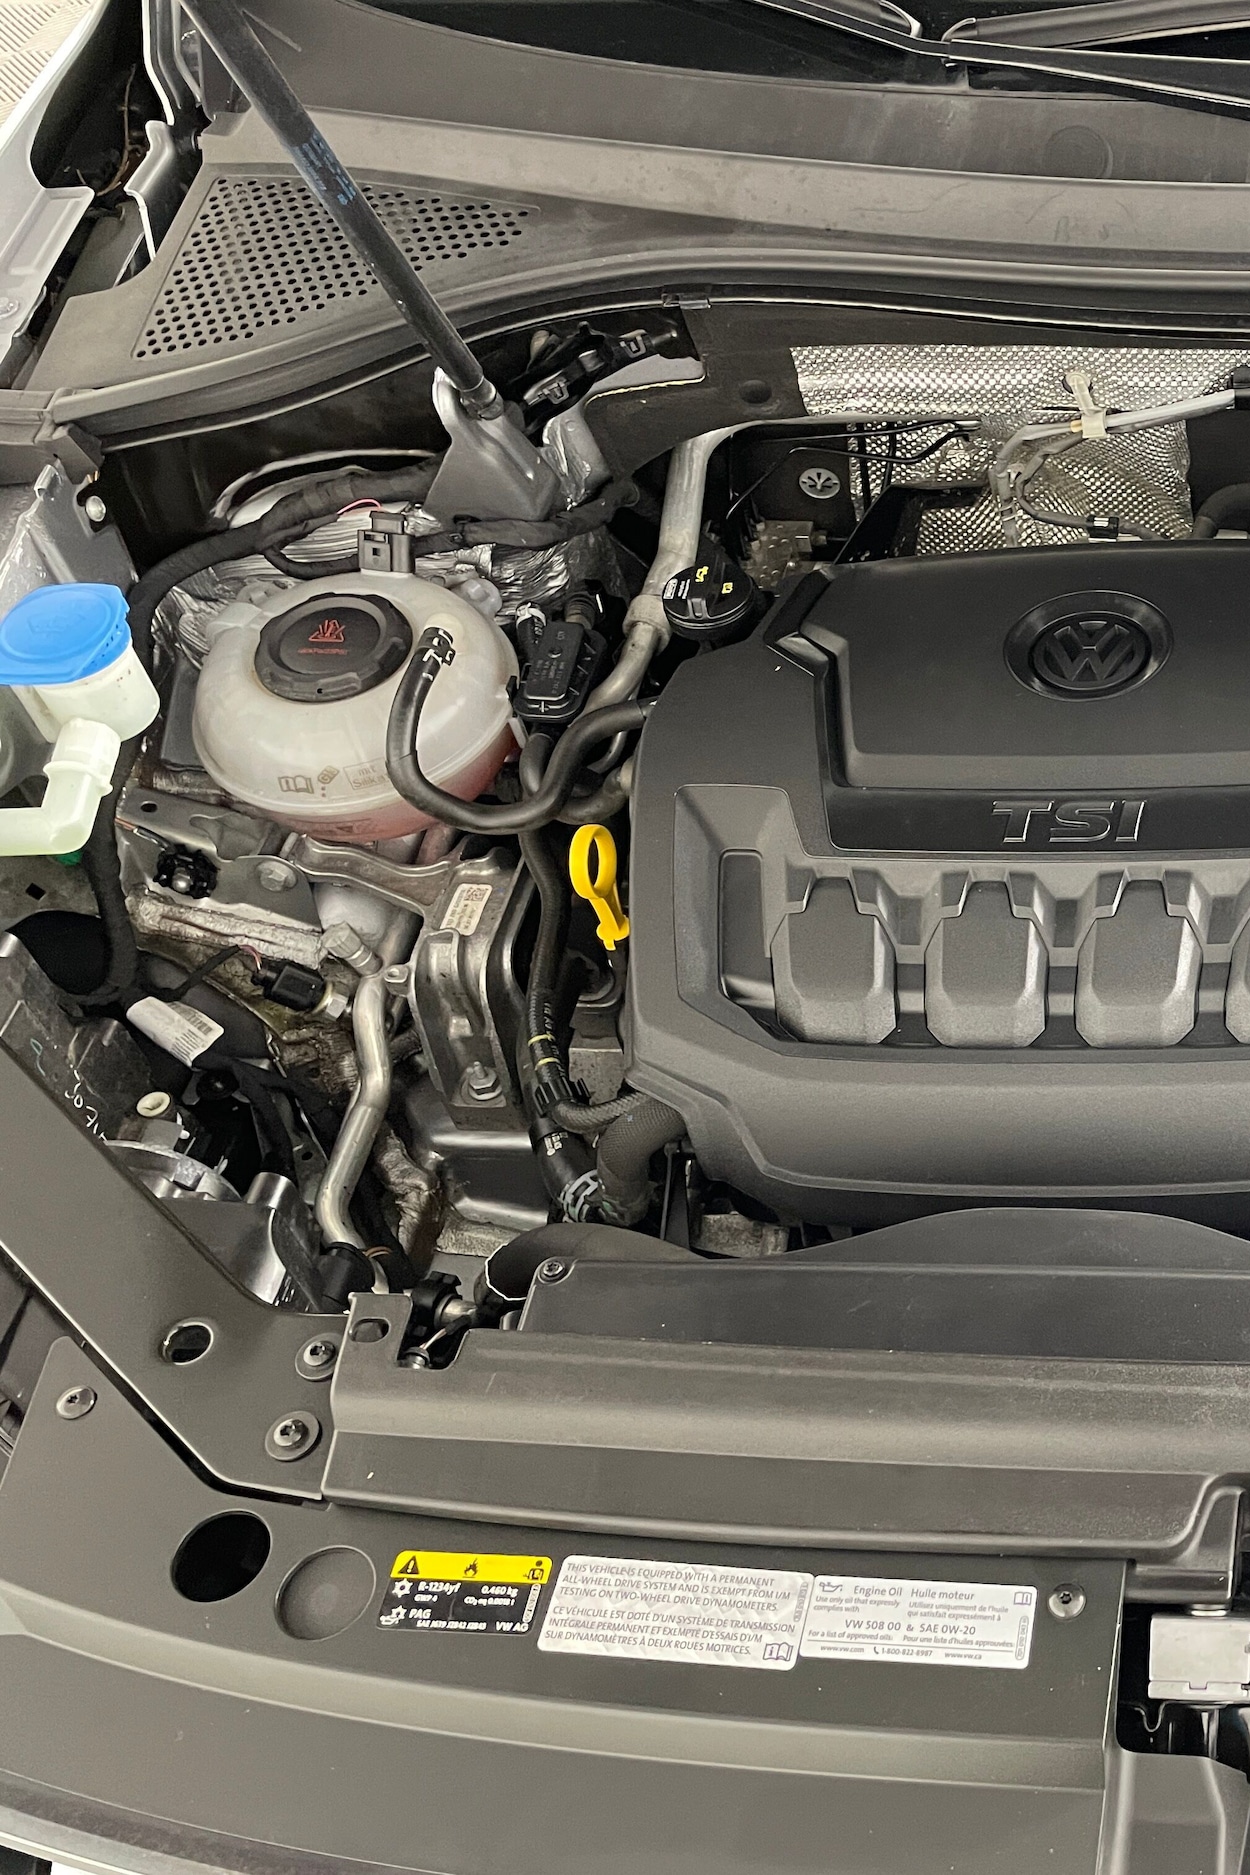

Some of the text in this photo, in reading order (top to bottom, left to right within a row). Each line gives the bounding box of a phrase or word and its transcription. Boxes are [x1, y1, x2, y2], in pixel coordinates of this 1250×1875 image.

[992, 800, 1146, 842] TSI
[567, 1563, 587, 1572] THIS
[590, 1564, 627, 1574] VEHICLE
[638, 1568, 682, 1580] EQUIPPED
[685, 1572, 708, 1581] WITH
[710, 1574, 717, 1582] A
[720, 1575, 775, 1586] PERMANENT
[418, 1581, 461, 1595] R-1234yf
[507, 1586, 518, 1597] kg
[560, 1587, 596, 1597] TESTING
[598, 1590, 613, 1598] ON
[615, 1591, 671, 1603] TWO-WHEEL
[674, 1596, 700, 1606] DRIVE
[562, 1575, 790, 1600] ALL-WHEEL DRIVE SYSTEM AND IS EXEMPT FROM I/M
[854, 1586, 902, 1597] Engine Oil
[911, 1588, 975, 1600] Huile moteur
[409, 1608, 431, 1619] PAG
[553, 1606, 795, 1633] CE VÉHICULE EST DOTÉ D'UN SYSTÈME DE TRANSMISSION
[496, 1621, 528, 1632] VW AG
[549, 1618, 595, 1629] INTÉGRALE
[596, 1622, 650, 1633] PERMANENT
[651, 1626, 662, 1634] ET
[702, 1630, 738, 1640] D'ESSAIS
[845, 1620, 976, 1635] VW 508 00 & SAE 0W-20
[545, 1630, 563, 1638] SUR
[564, 1631, 638, 1645] DYNAMOMÈTRES
[639, 1636, 646, 1646] À
[648, 1638, 672, 1648] DEUX
[675, 1642, 704, 1651] ROUES
